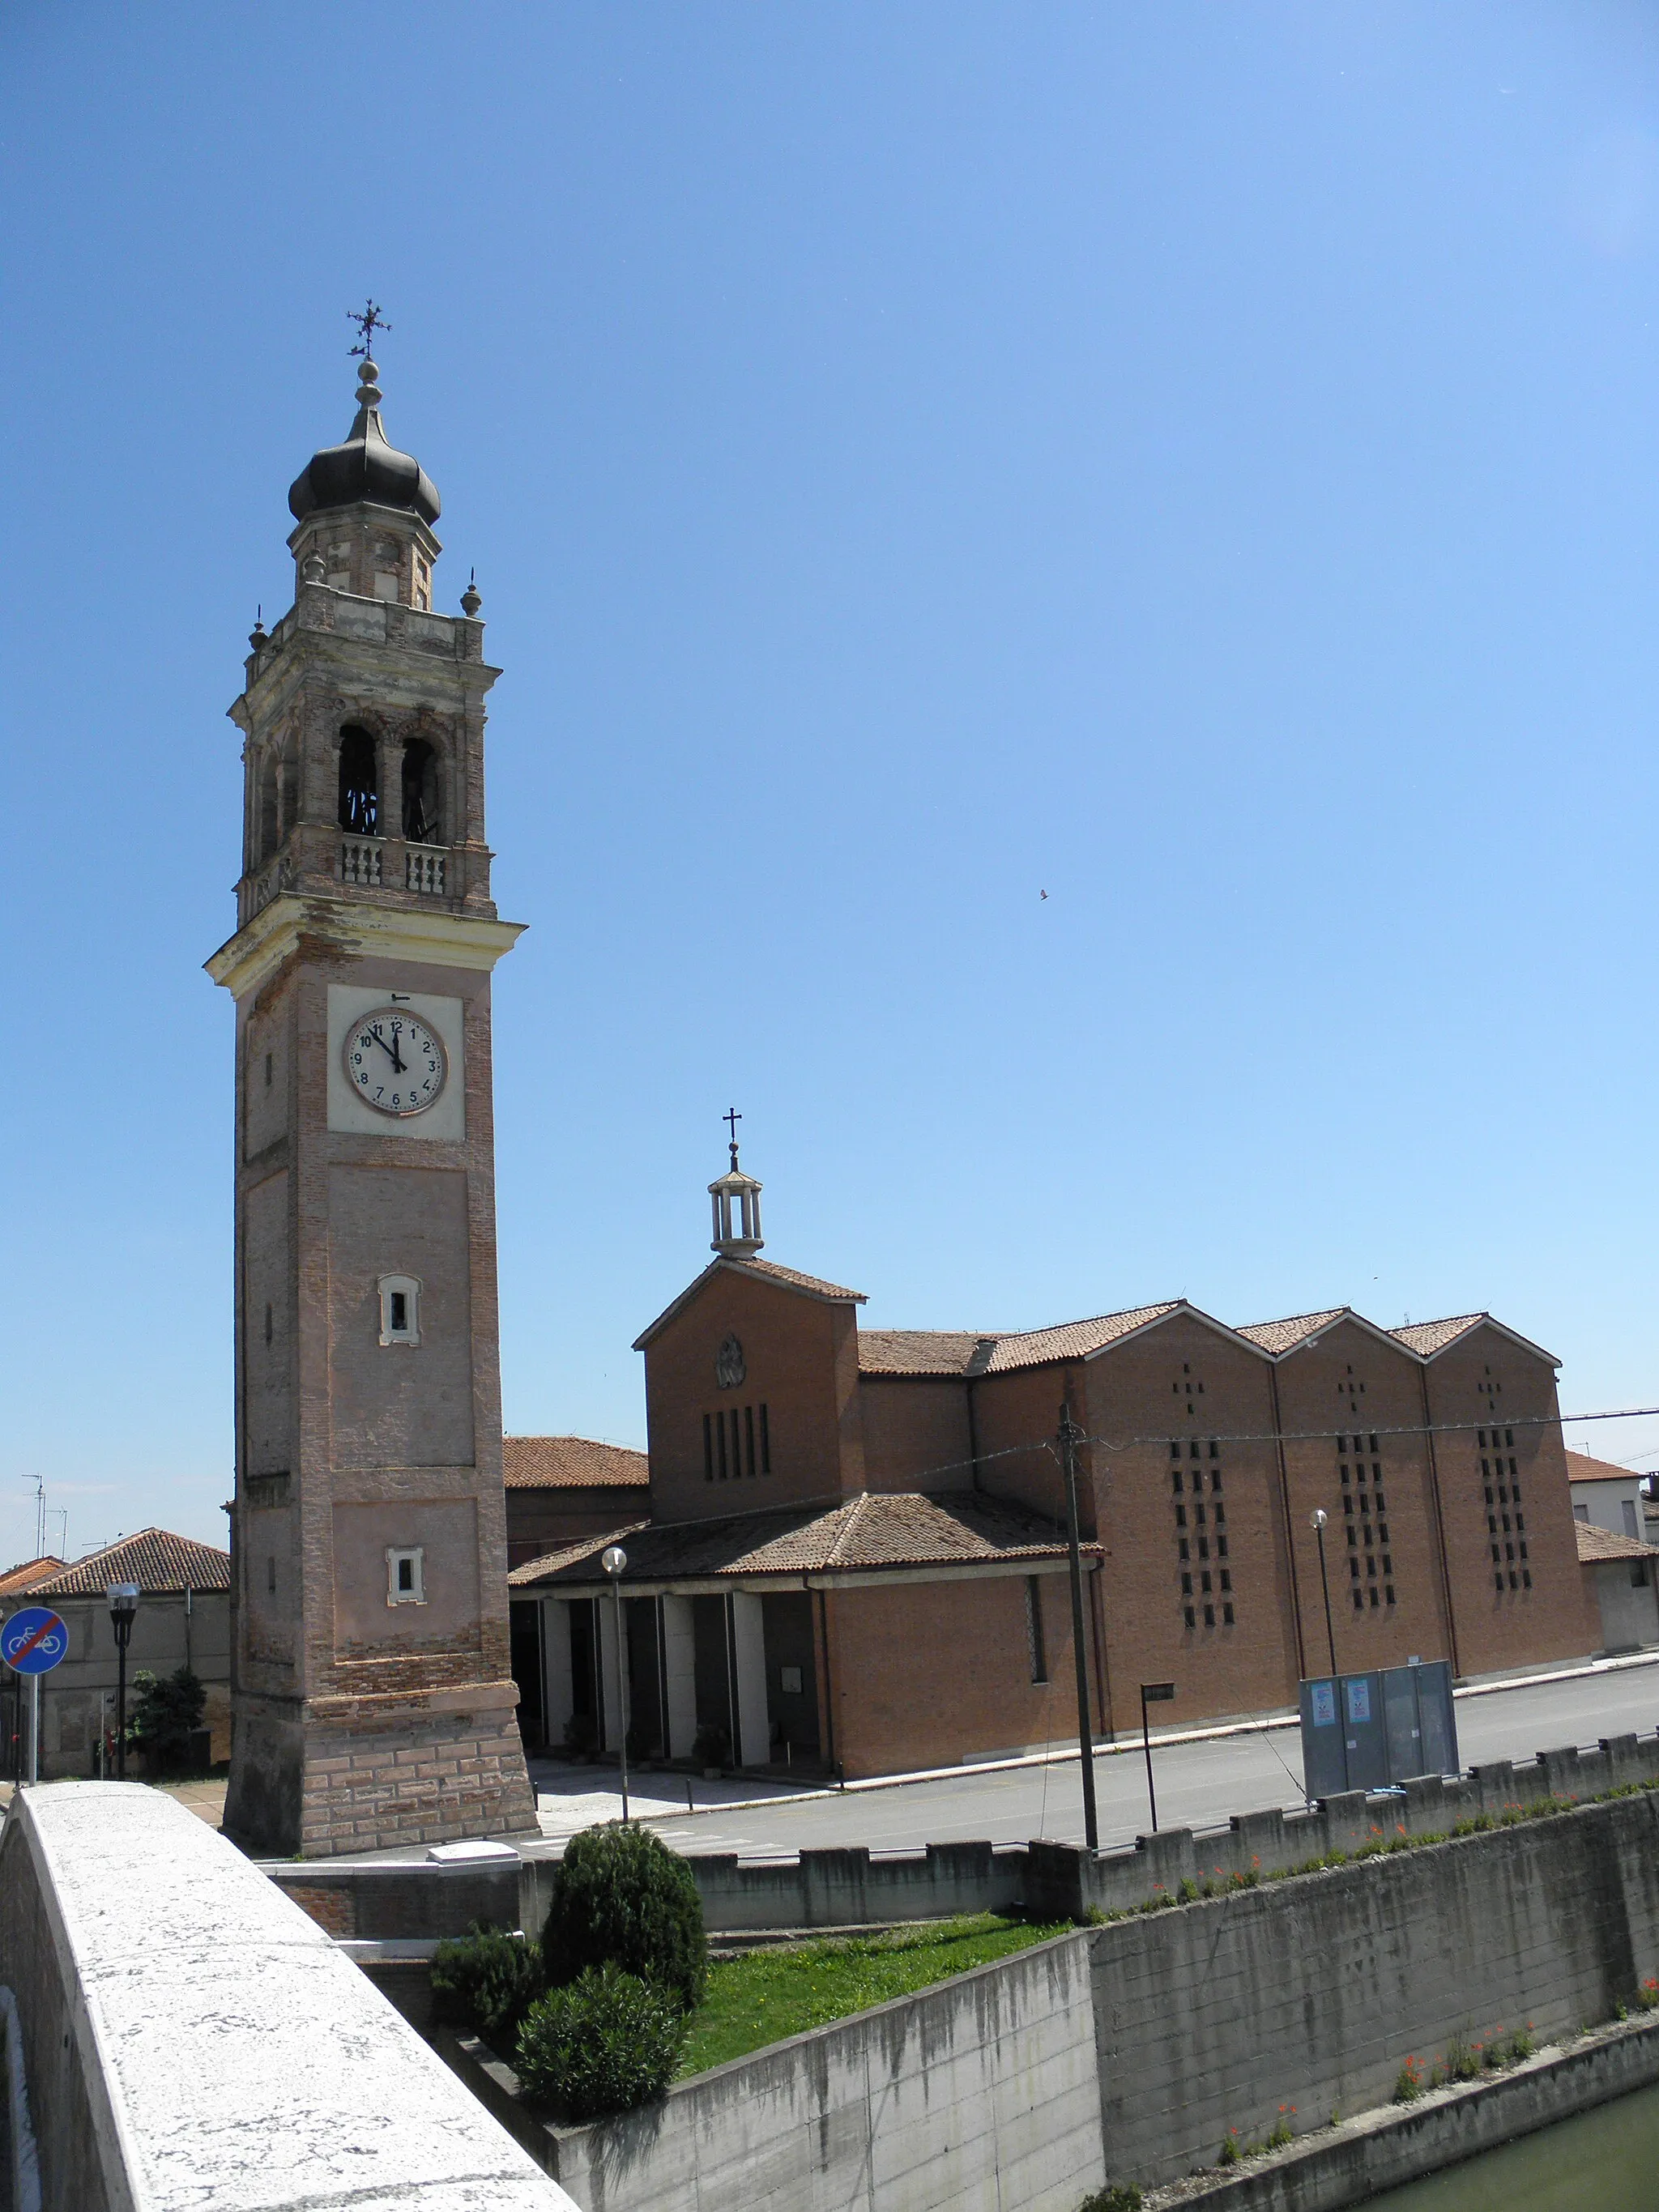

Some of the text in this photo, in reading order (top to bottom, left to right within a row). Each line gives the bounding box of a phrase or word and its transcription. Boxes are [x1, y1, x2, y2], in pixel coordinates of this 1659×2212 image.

[373, 1025, 383, 1036] 11
[390, 1021, 403, 1033] 12
[411, 1029, 416, 1039] 1
[360, 1036, 371, 1047] 10
[423, 1042, 430, 1053] 2
[354, 1053, 362, 1064] 9
[429, 1061, 436, 1072] 3
[360, 1073, 369, 1084] 8
[422, 1079, 430, 1090] 4
[376, 1087, 384, 1098] 7
[410, 1092, 417, 1102] 5
[392, 1094, 400, 1105] 6
